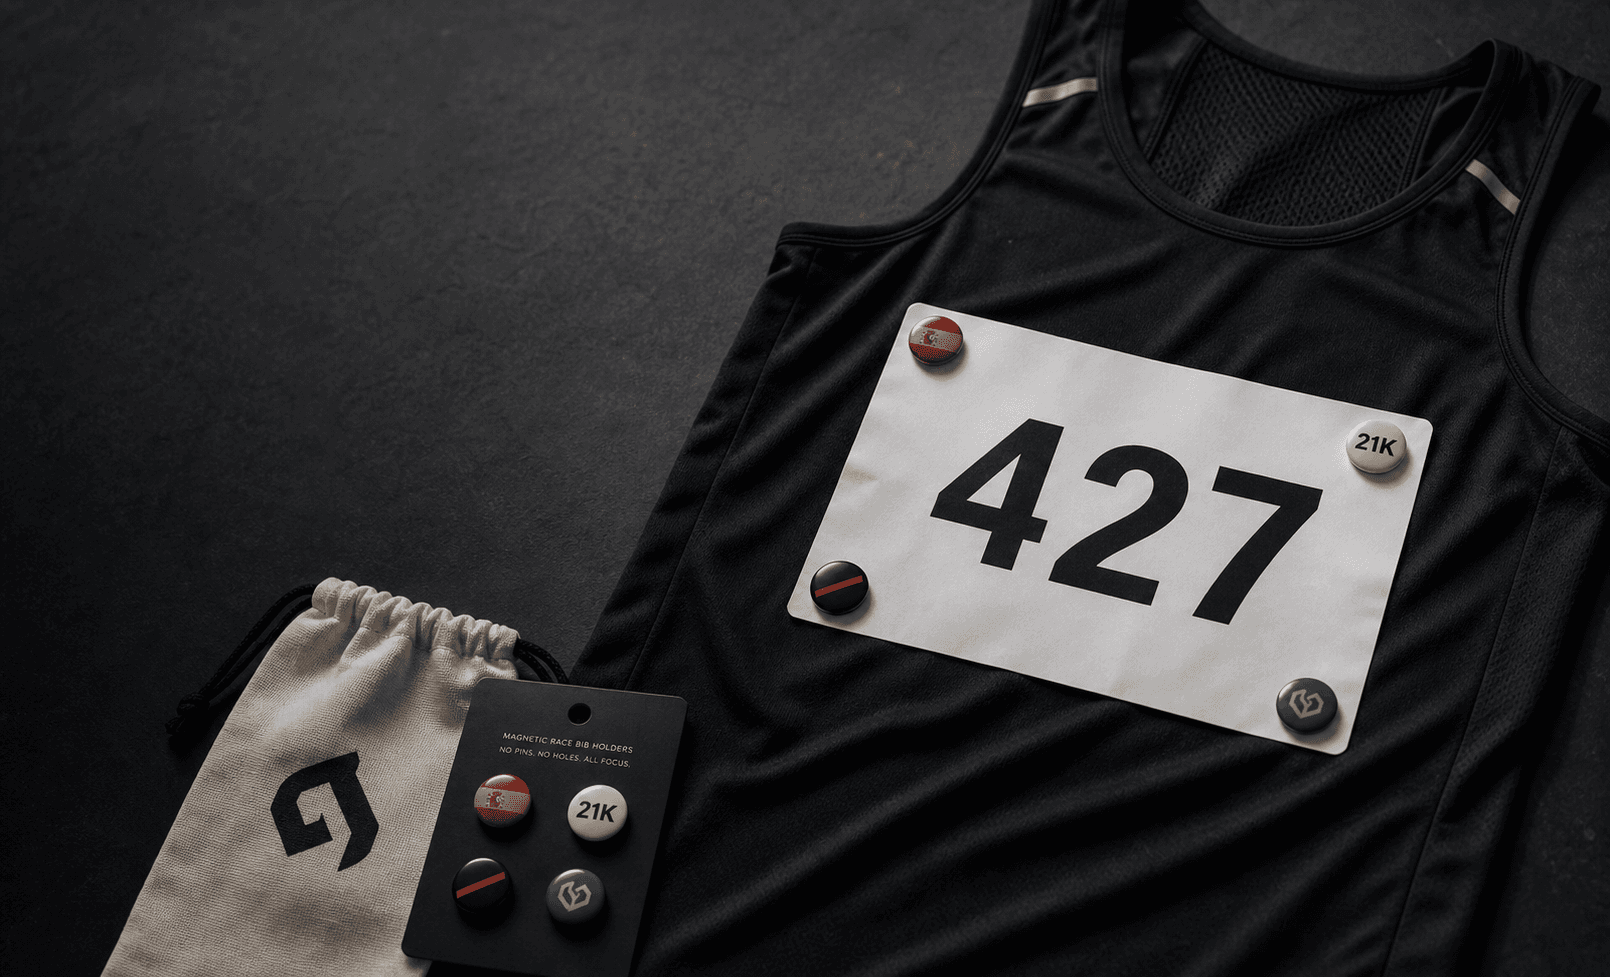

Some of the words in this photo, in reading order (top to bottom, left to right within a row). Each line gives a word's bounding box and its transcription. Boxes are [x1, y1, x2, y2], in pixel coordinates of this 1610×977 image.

[1355, 433, 1397, 457] 21K
[930, 418, 1323, 625] 427
[503, 732, 548, 744] MAGNETIC
[550, 738, 572, 747] RACE
[592, 743, 633, 754] HOLDERS
[499, 746, 512, 754] NO
[514, 748, 535, 757] PINS.
[552, 753, 580, 762] HOLES.
[583, 756, 598, 764] ALL
[600, 758, 631, 768] FOCUS.
[576, 801, 618, 823] 21K
